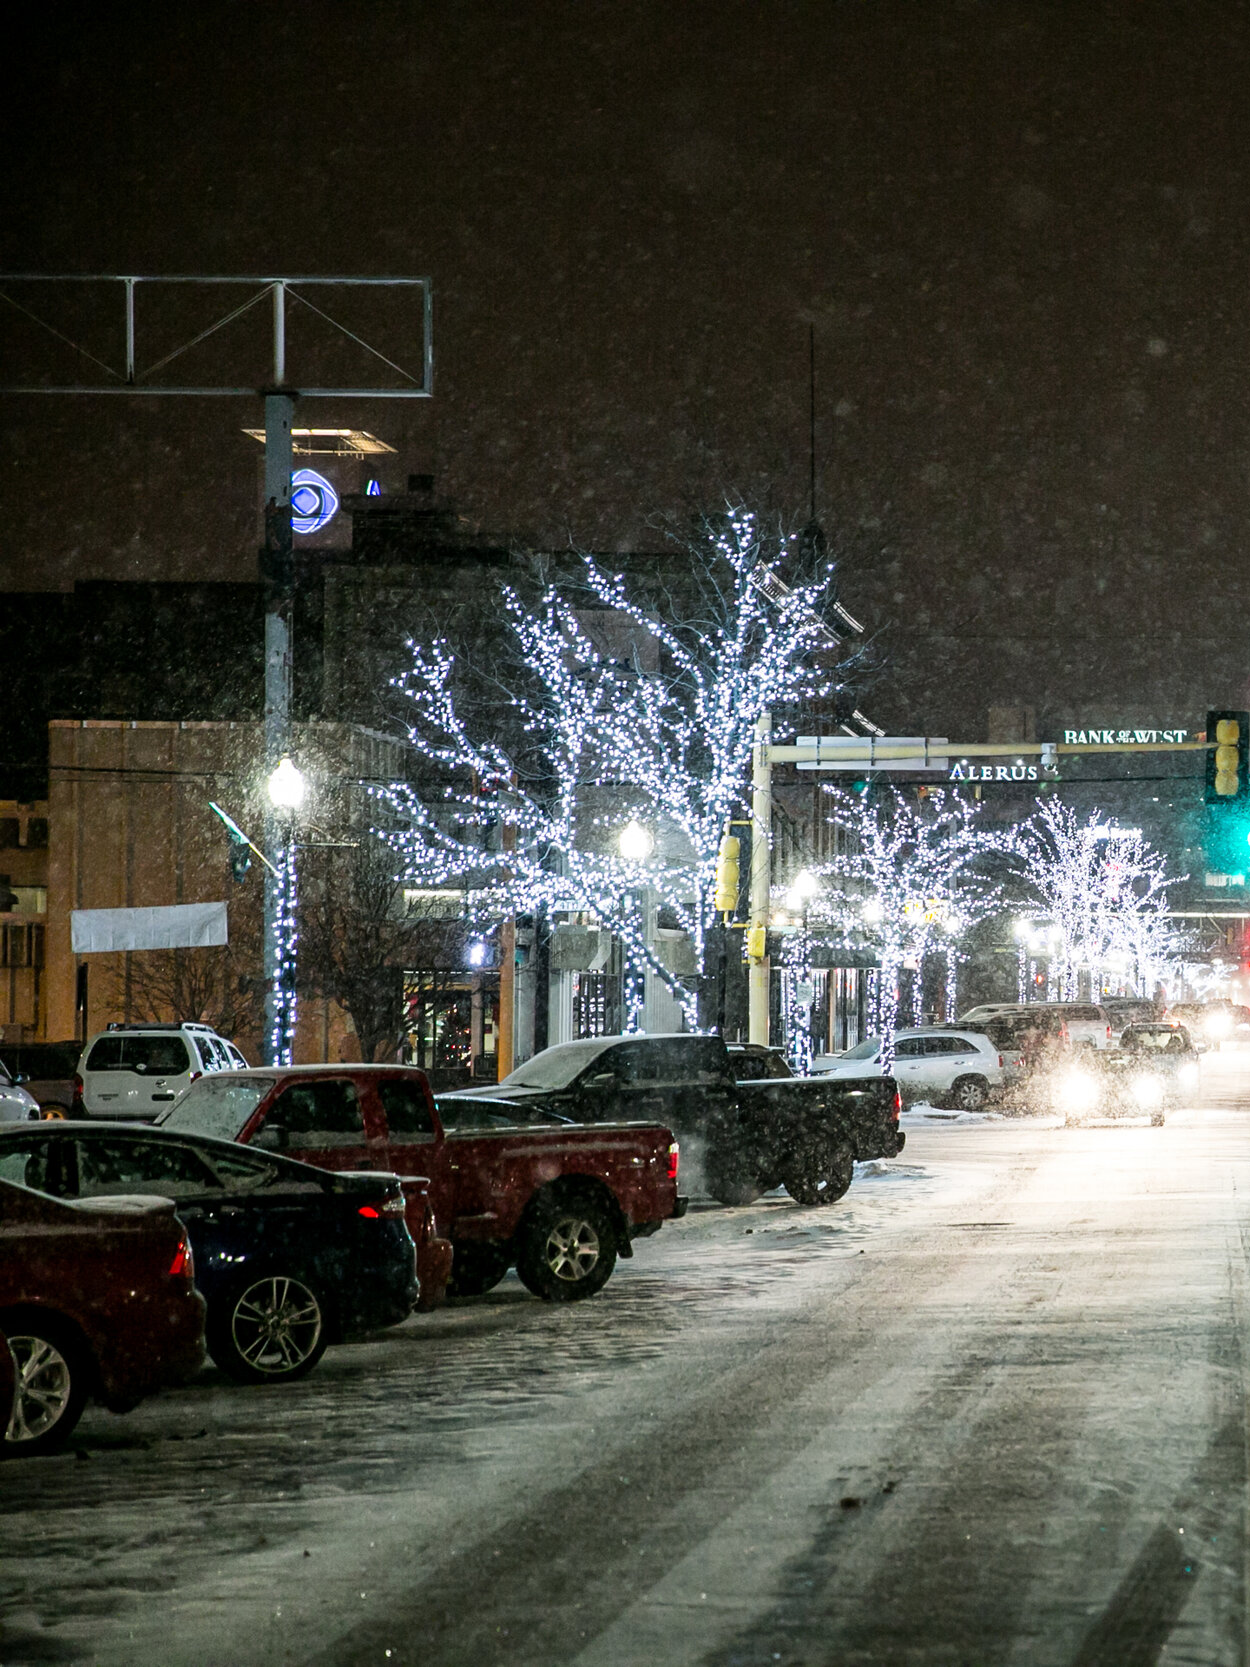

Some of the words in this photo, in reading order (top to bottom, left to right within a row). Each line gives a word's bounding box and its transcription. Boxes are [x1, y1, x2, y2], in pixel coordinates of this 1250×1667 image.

[1064, 730, 1115, 744] BANK
[1134, 730, 1187, 743] WEST
[949, 763, 1038, 781] ALERUS
